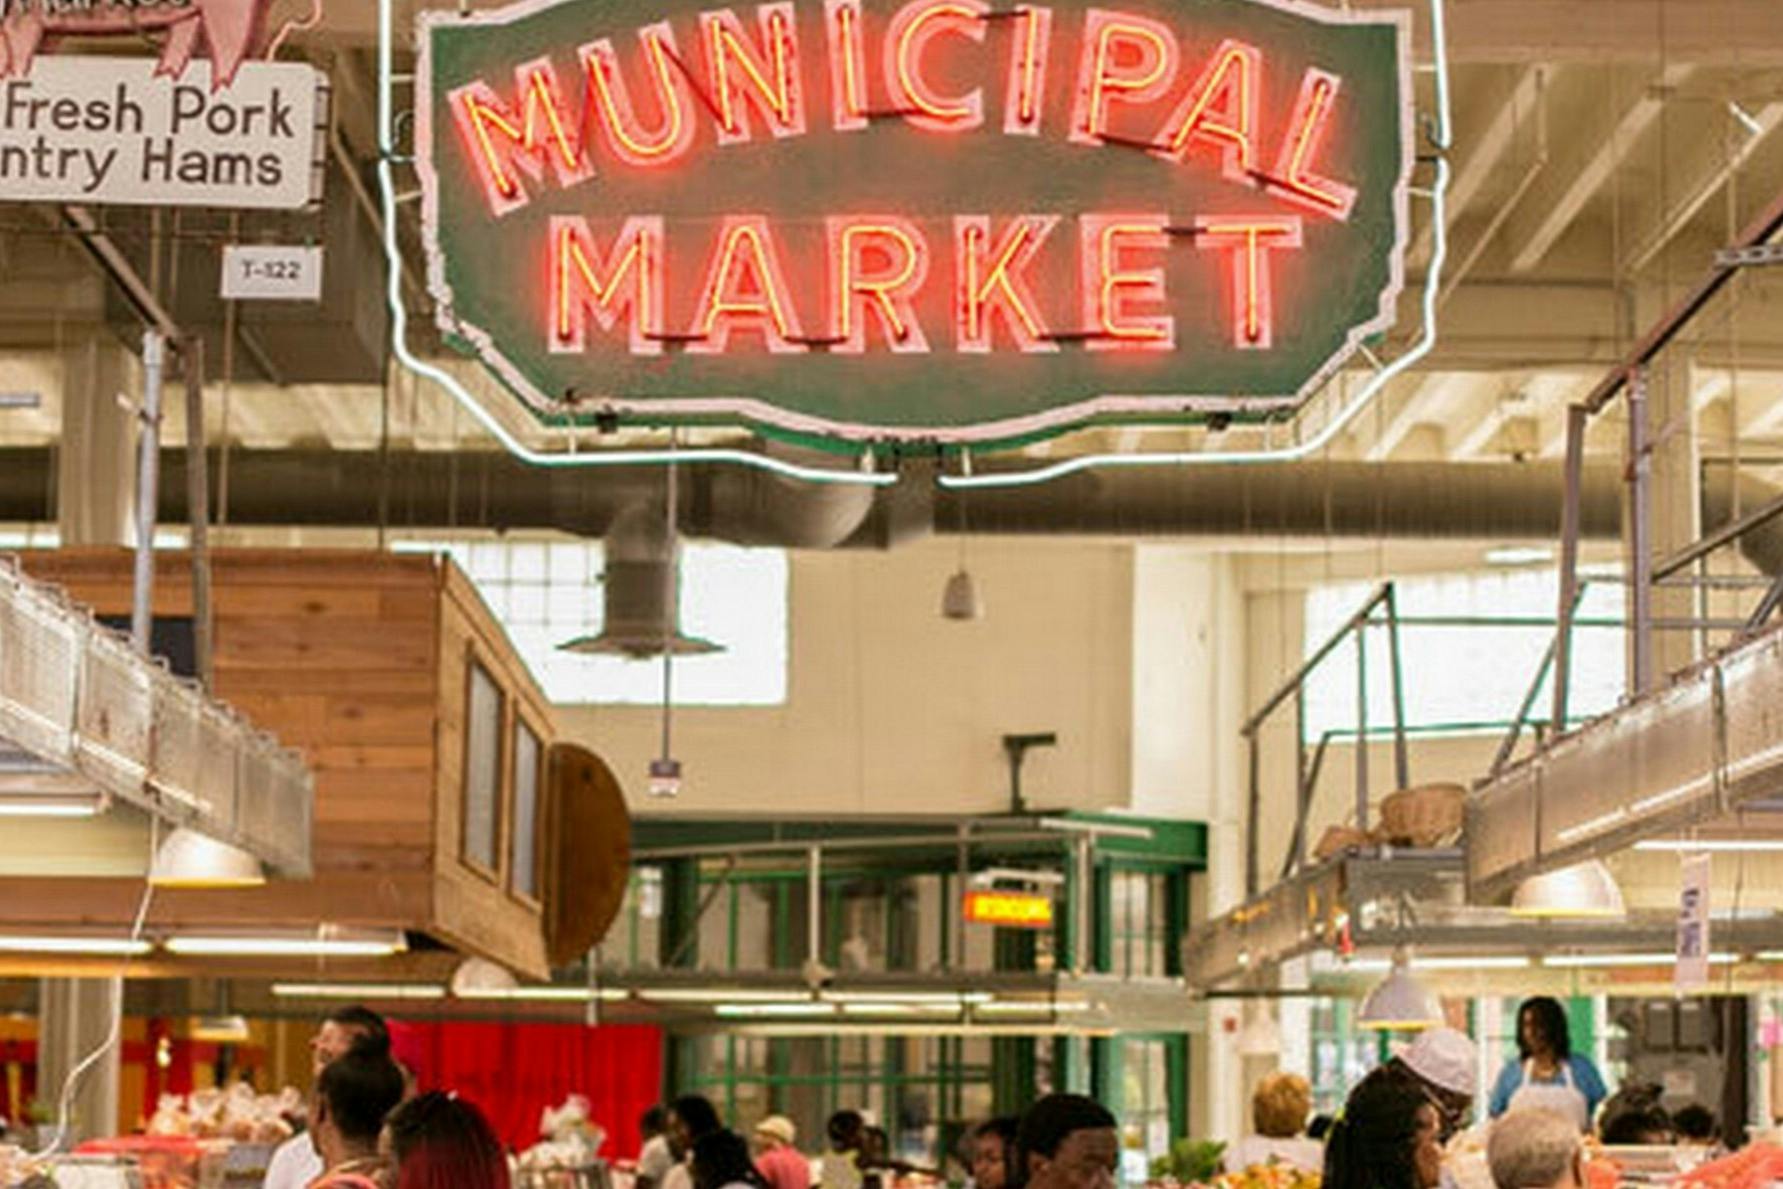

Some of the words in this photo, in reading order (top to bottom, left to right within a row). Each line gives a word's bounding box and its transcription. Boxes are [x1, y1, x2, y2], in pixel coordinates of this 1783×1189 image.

[5, 81, 143, 133] Fresh
[171, 85, 294, 138] Pork
[447, 0, 1358, 222] MUNICIPAL
[0, 135, 118, 193] ntry
[142, 137, 283, 186] Hams
[548, 214, 1303, 354] MARKET
